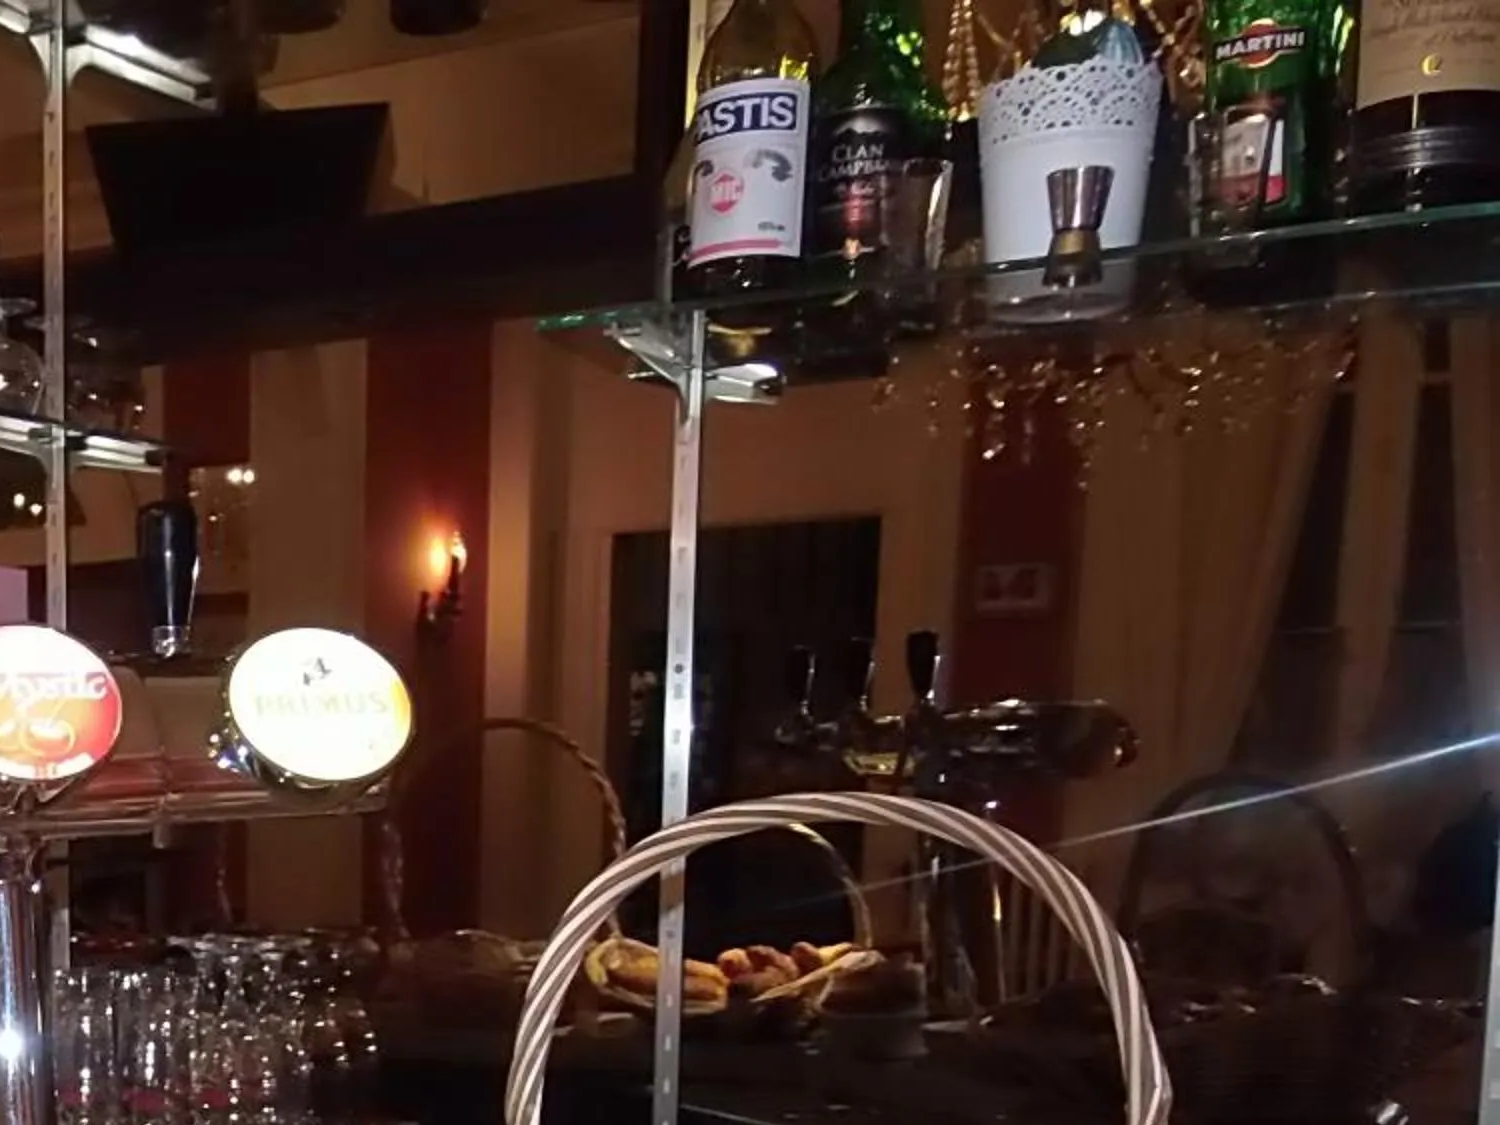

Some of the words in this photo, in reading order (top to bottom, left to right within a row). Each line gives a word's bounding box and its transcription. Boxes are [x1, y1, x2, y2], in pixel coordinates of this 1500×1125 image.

[1215, 30, 1305, 61] MARTINI
[831, 143, 884, 161] CLAN
[254, 690, 390, 717] PRIMUS
